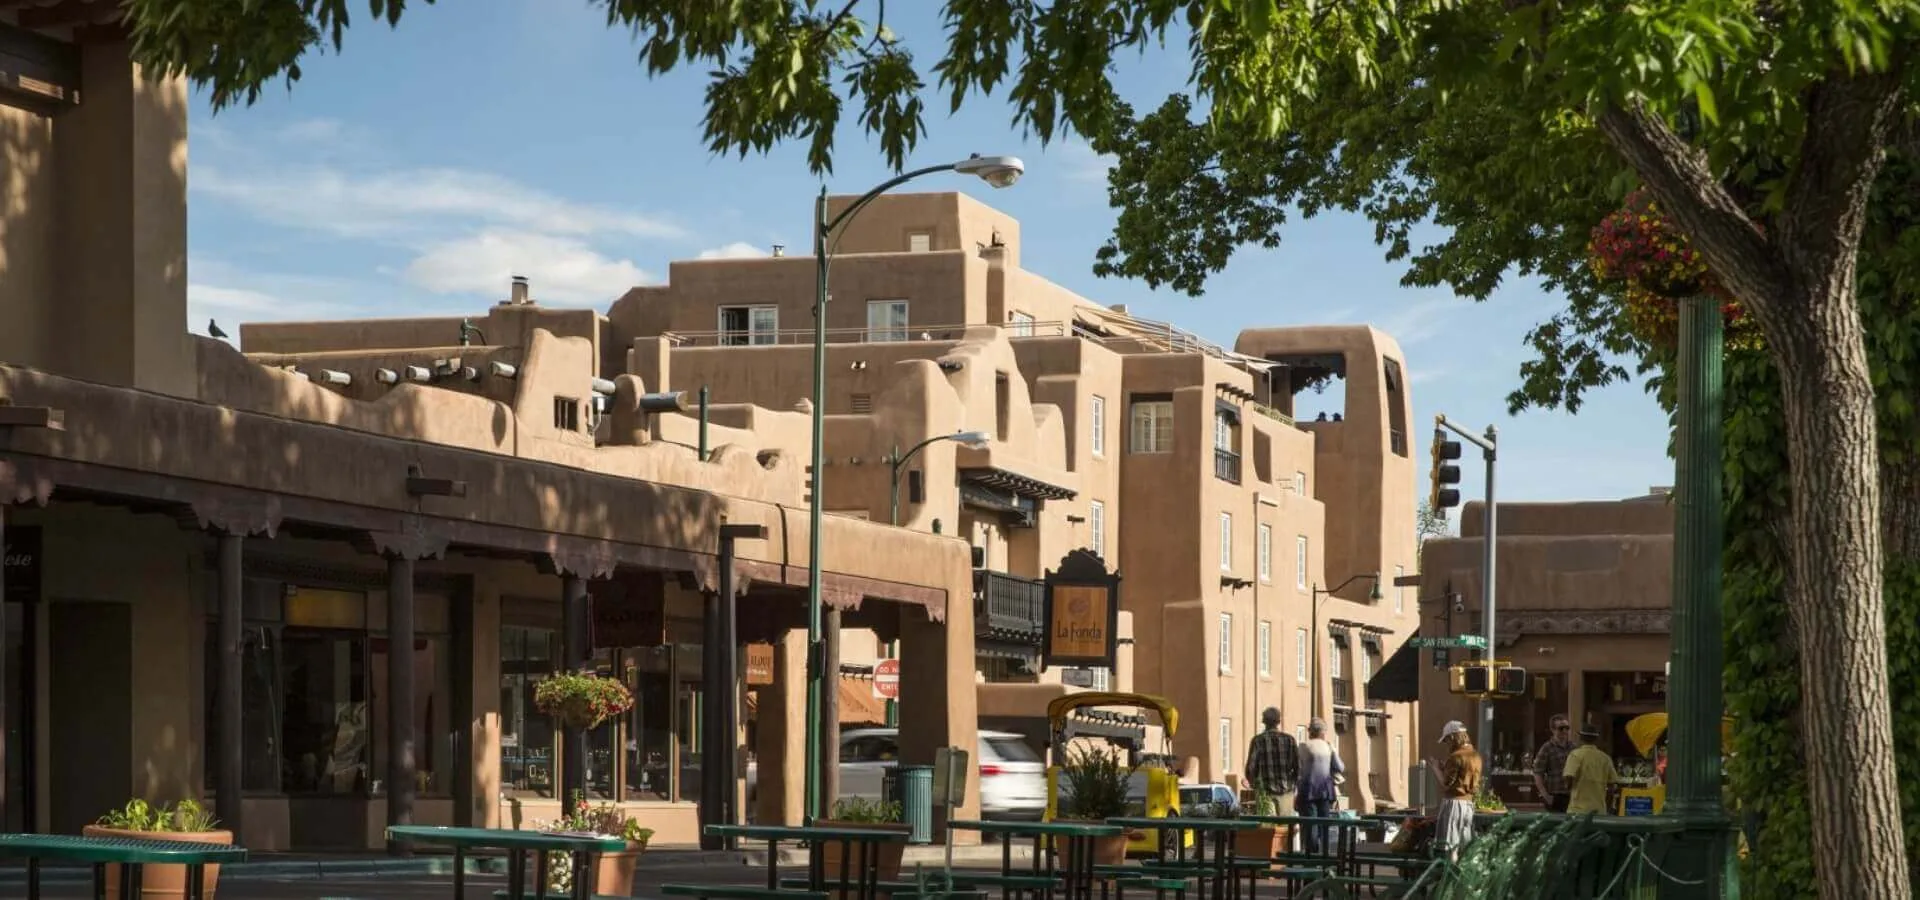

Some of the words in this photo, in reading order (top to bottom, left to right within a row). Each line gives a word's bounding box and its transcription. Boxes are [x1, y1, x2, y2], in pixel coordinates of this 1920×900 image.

[1056, 620, 1068, 638] La
[1071, 621, 1102, 641] Fonda
[1423, 638, 1435, 648] SAN
[879, 666, 890, 674] DO
